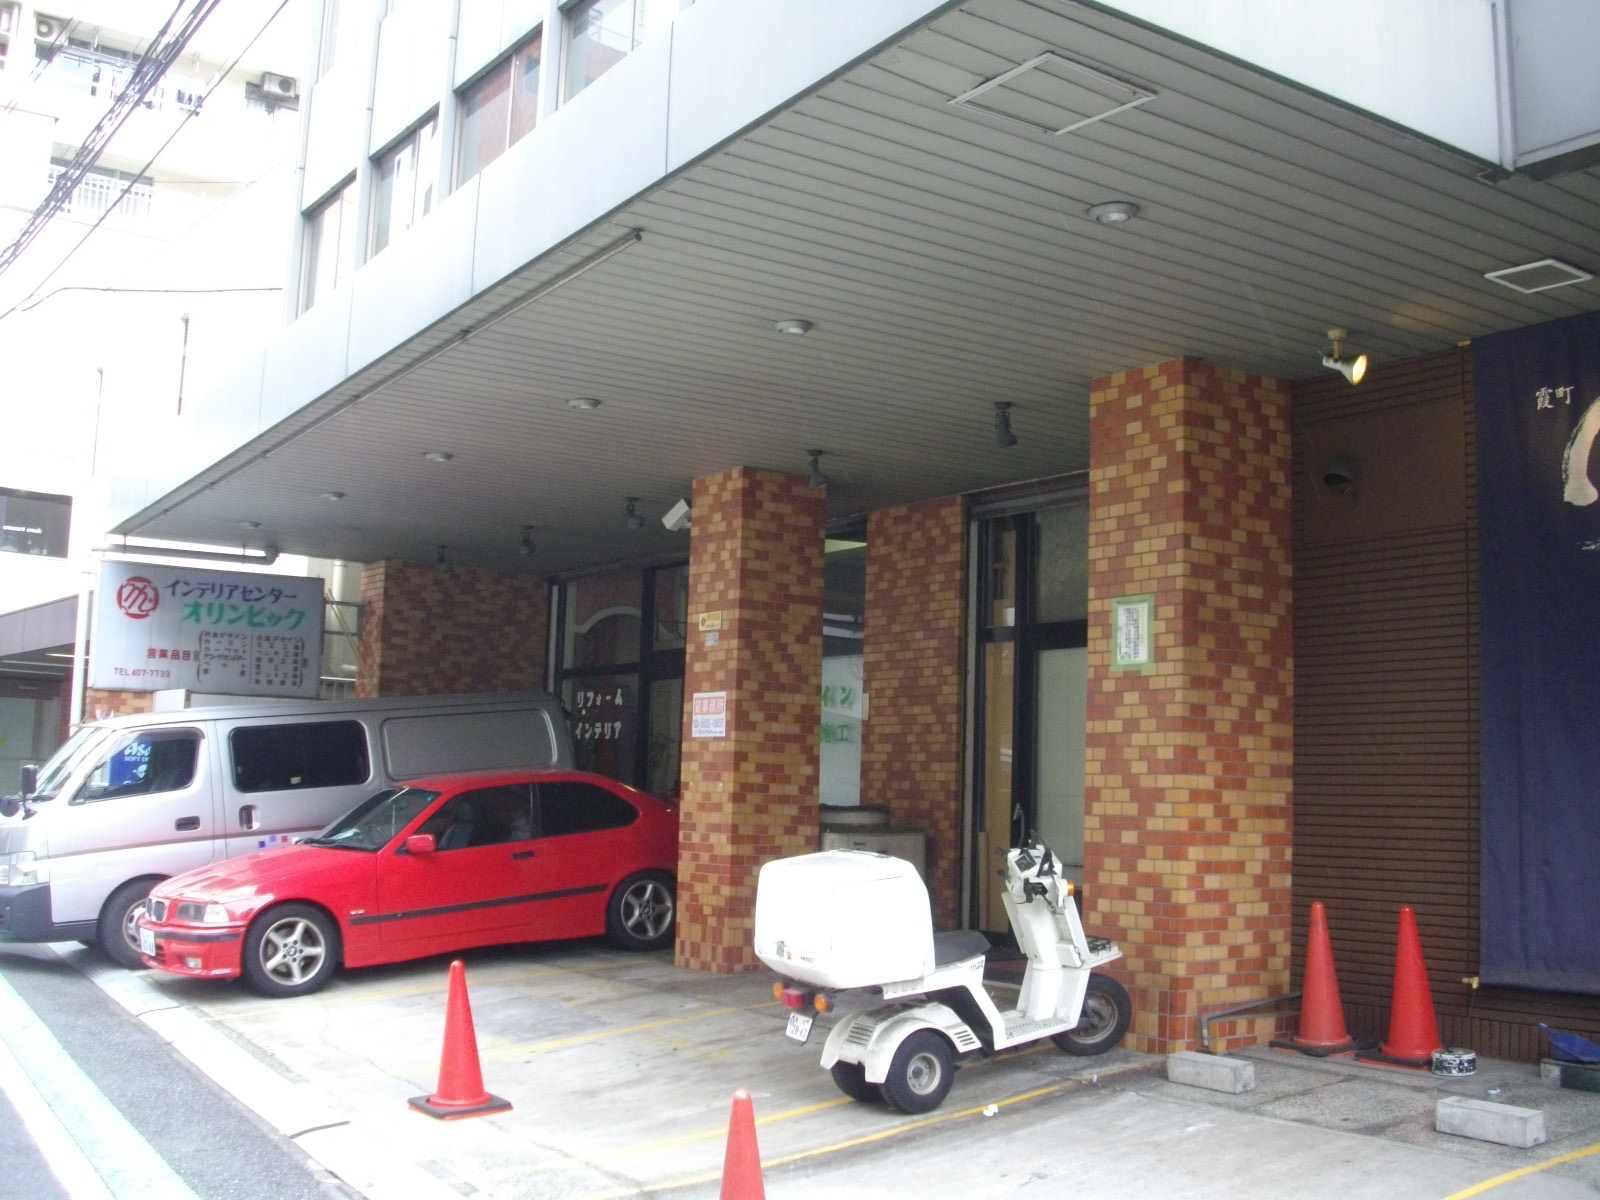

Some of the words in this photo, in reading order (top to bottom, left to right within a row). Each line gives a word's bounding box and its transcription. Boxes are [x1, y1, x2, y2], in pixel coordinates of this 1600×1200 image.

[1536, 386, 1575, 410] 霞町
[165, 580, 297, 604] インテリアセンター
[147, 648, 191, 661] 営業品目
[114, 667, 130, 676] TEL
[577, 688, 623, 708] リフォーム
[575, 721, 622, 740] インテリア
